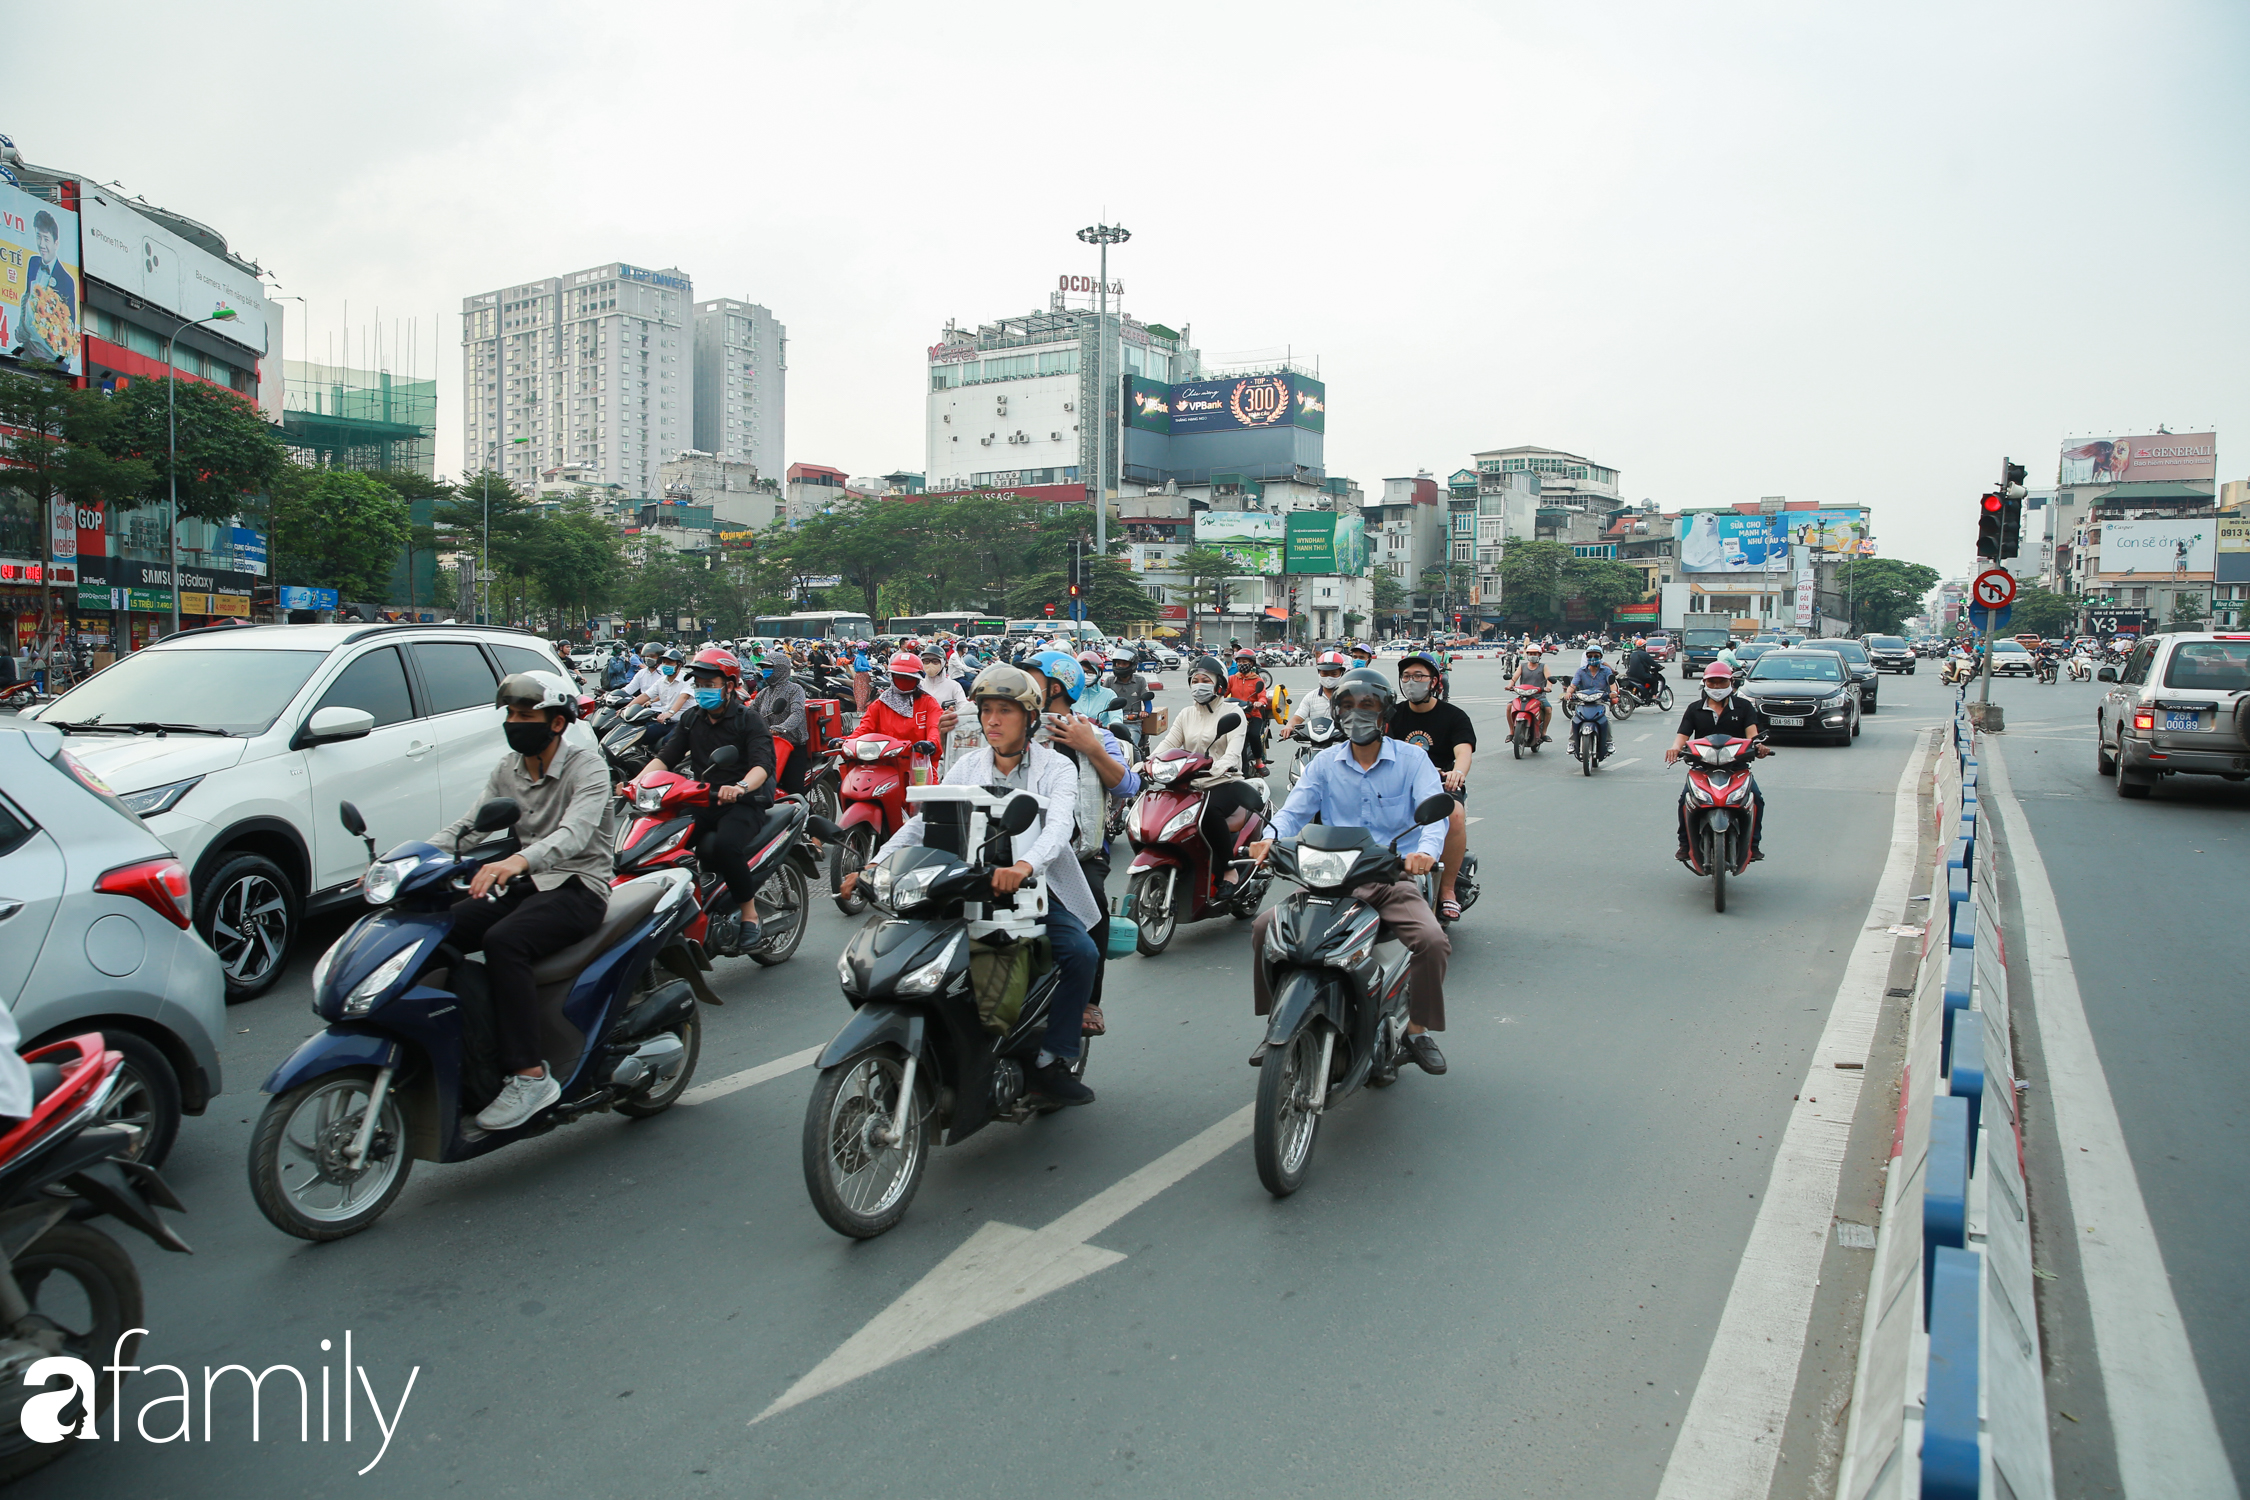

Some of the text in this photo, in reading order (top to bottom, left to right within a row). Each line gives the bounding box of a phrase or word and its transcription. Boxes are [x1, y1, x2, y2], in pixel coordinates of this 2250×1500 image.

[652, 273, 693, 291] INVEST
[1060, 275, 1090, 292] OCD
[1189, 399, 1223, 411] VPBank
[1244, 387, 1275, 412] 300
[2152, 446, 2211, 458] GENERALI
[1730, 520, 1744, 529] SỮA
[1739, 529, 1759, 538] MẠNH
[2221, 528, 2242, 537] 0913
[2117, 537, 2139, 548] Con
[2142, 536, 2156, 548] sẽ
[2159, 535, 2168, 548] ở
[142, 568, 185, 587] SAMSUG
[185, 572, 214, 592] Galaxy
[2091, 617, 2118, 633] Y-3
[2166, 720, 2198, 730] 000.89
[428, 1005, 457, 1018] HONDA
